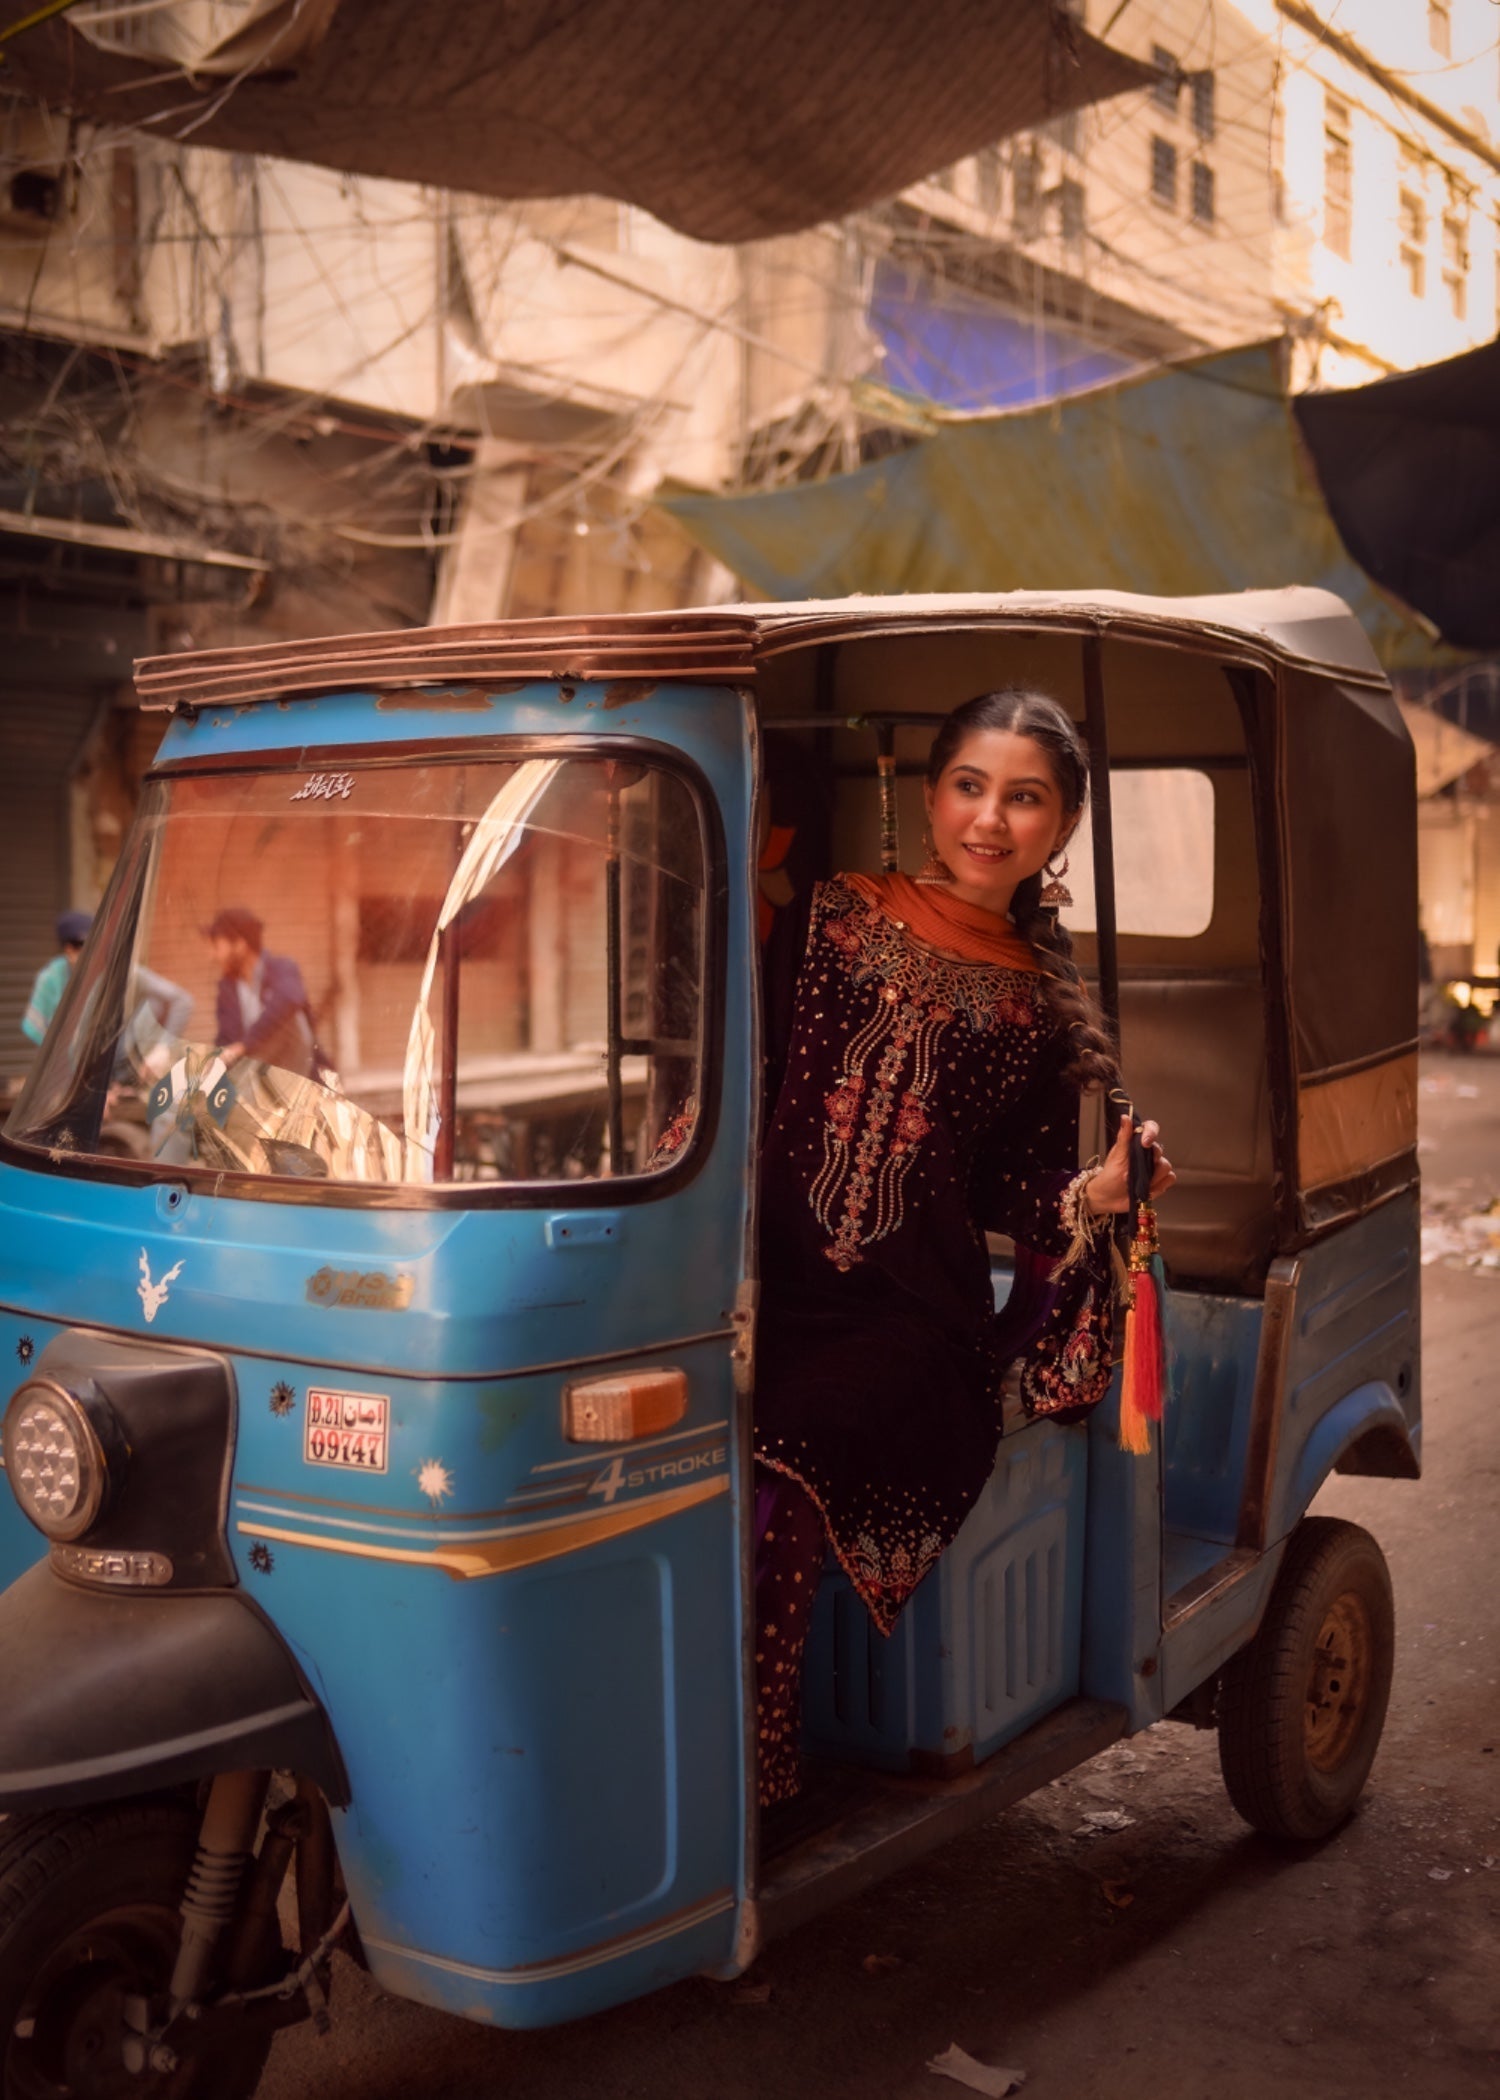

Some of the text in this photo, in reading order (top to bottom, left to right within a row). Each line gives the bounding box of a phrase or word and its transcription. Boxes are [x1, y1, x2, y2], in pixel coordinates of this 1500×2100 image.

[311, 1429, 380, 1465] 09747
[588, 1447, 726, 1502] 4 STROKE
